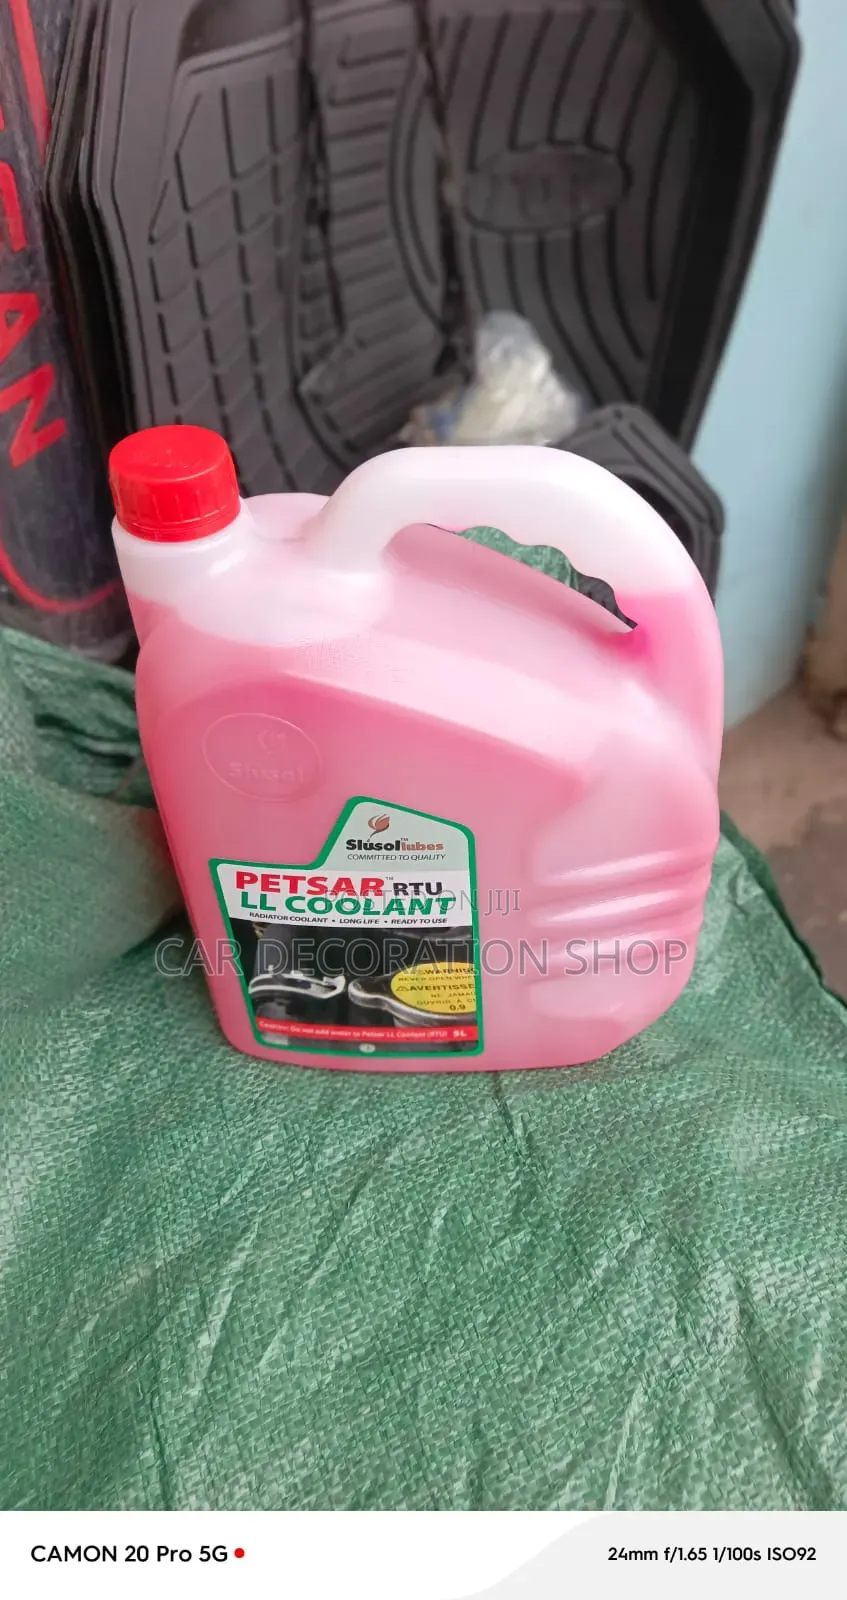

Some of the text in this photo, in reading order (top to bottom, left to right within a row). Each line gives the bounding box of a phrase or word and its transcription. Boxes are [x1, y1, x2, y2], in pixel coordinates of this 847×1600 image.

[347, 853, 446, 861] COMMITTED TO QUALITY
[235, 871, 385, 897] PETSAR
[393, 882, 443, 896] RTU
[241, 891, 457, 916] LL COOLANT
[249, 911, 289, 921] RADIATOR
[289, 915, 329, 923] COOLANT
